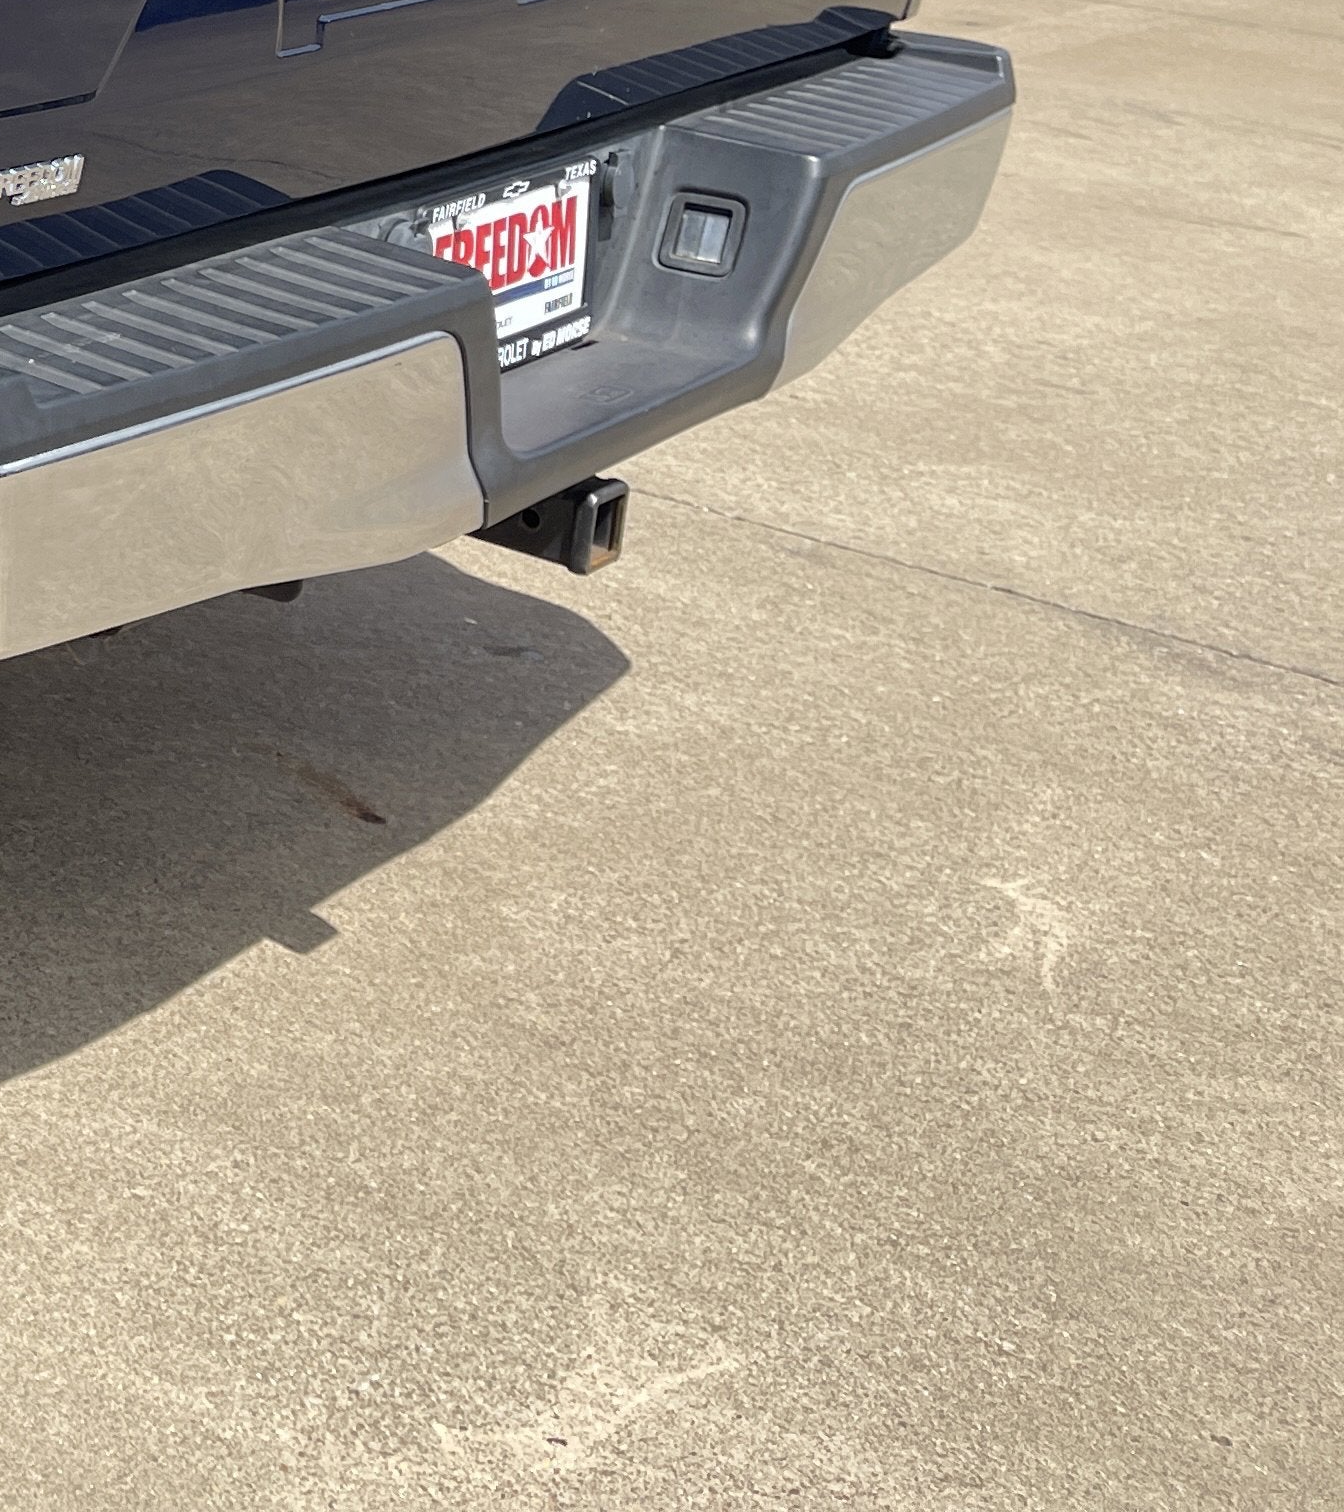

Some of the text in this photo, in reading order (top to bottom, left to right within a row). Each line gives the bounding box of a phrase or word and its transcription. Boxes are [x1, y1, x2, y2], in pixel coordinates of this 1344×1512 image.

[432, 159, 597, 224] FAIRFIELD TEXAS
[498, 337, 529, 368] ROLET
